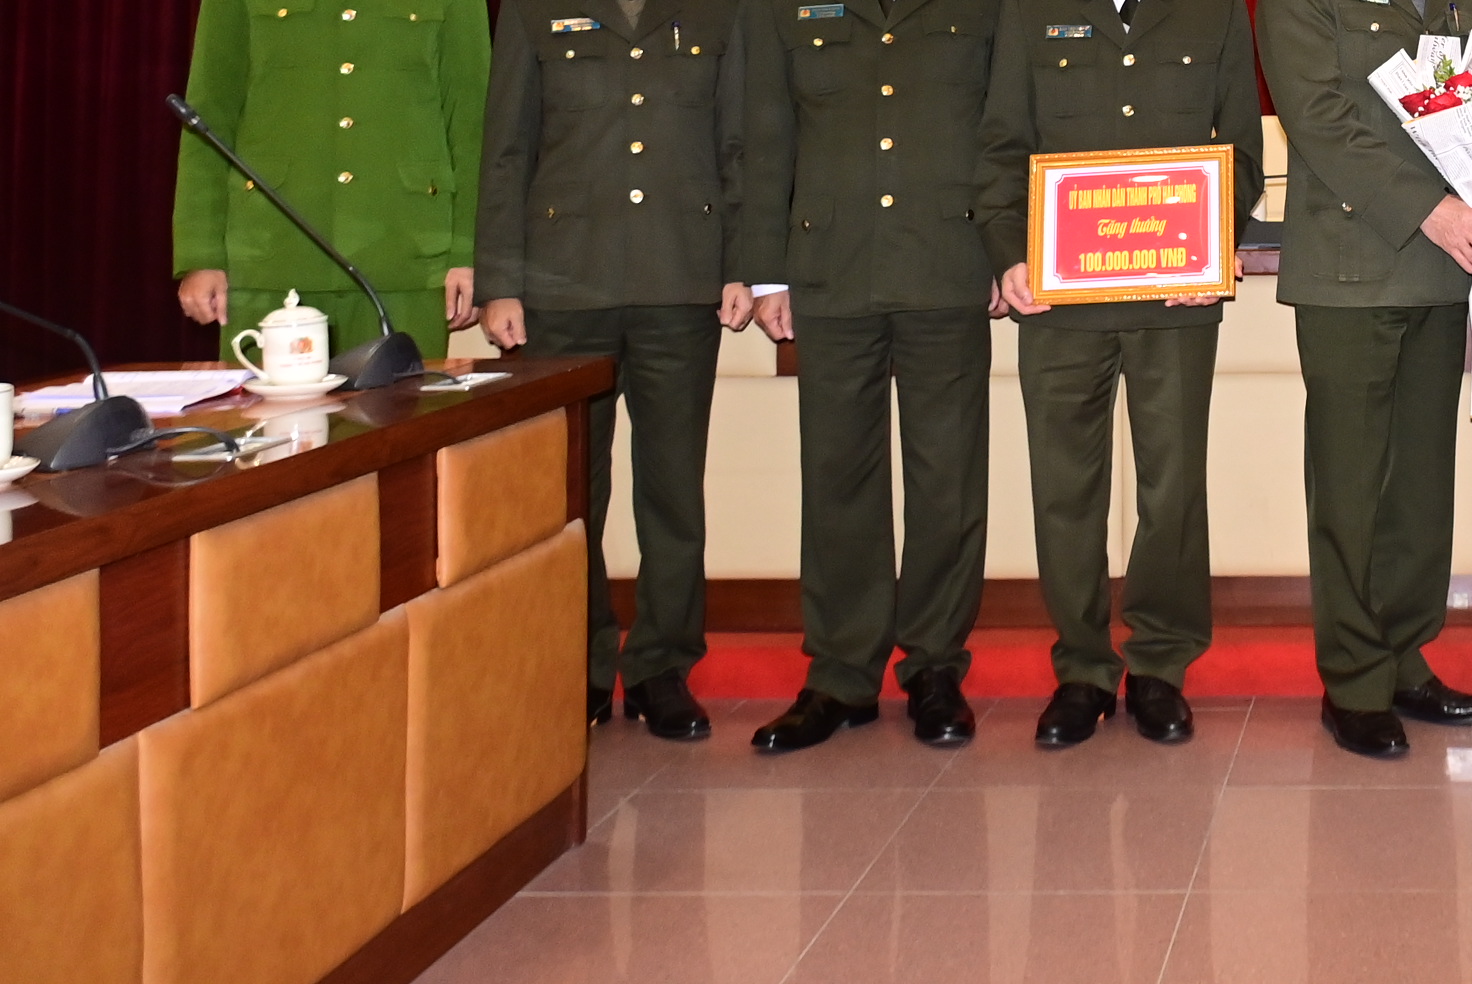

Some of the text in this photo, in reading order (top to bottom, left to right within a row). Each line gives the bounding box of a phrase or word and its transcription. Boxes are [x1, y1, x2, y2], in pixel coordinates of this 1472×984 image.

[1097, 215, 1168, 239] Tặng thưởng
[1079, 247, 1187, 272] 100.000.000 VNĐ
